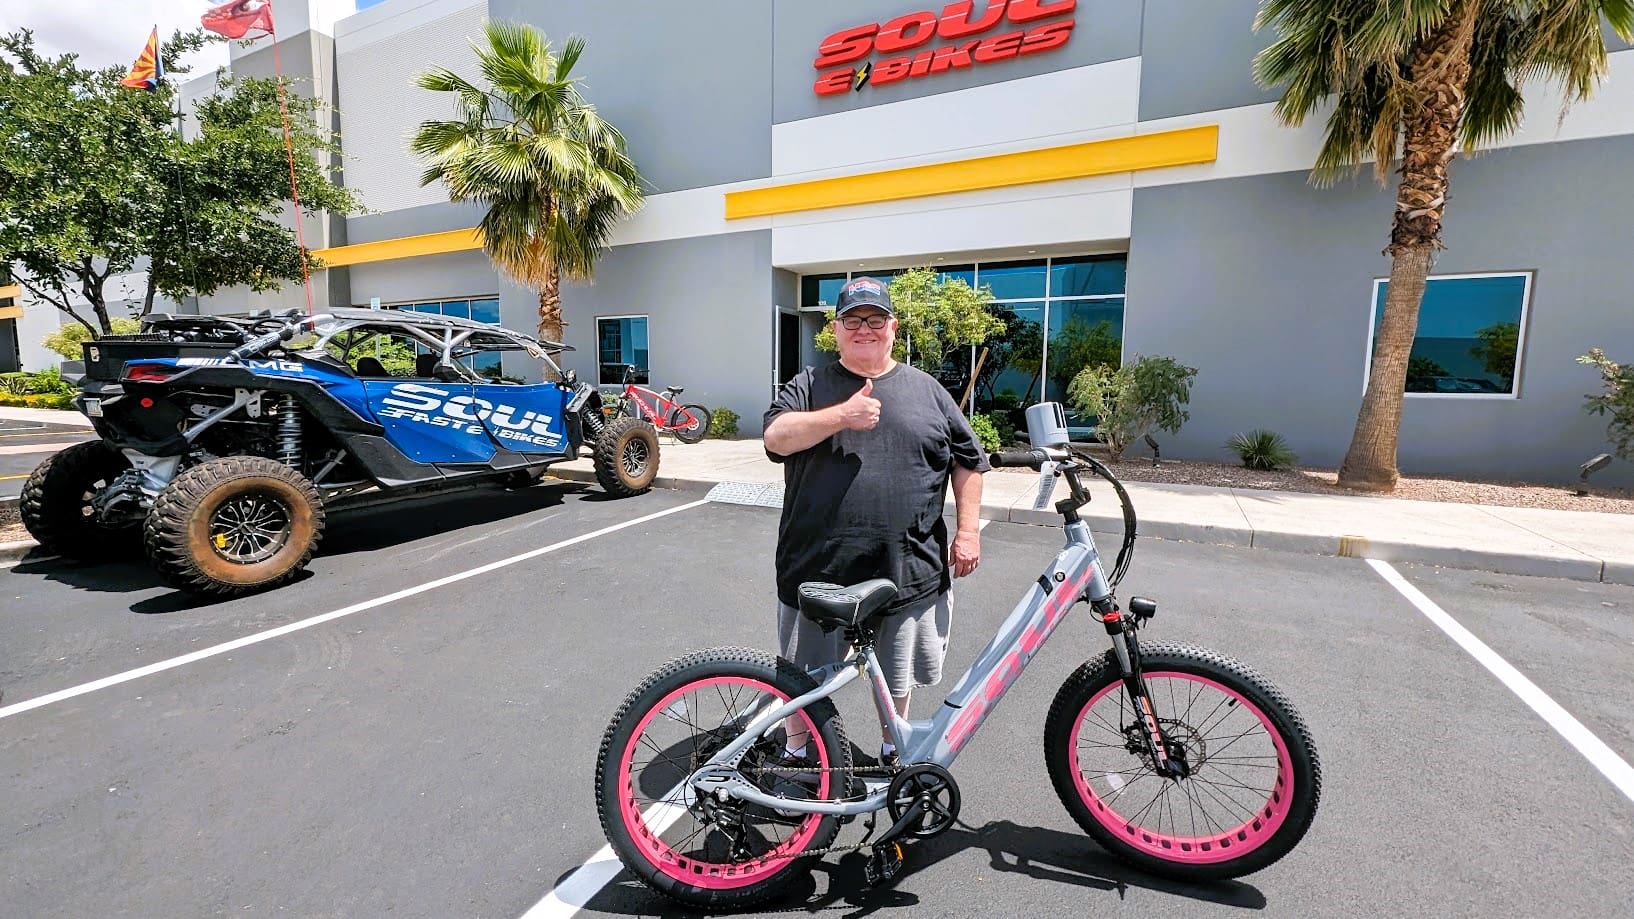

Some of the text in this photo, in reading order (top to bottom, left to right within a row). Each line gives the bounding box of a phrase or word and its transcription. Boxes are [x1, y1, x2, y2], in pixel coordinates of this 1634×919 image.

[814, 0, 1077, 70] SOUL
[382, 383, 563, 439] SOUL
[945, 564, 1095, 753] SOUL
